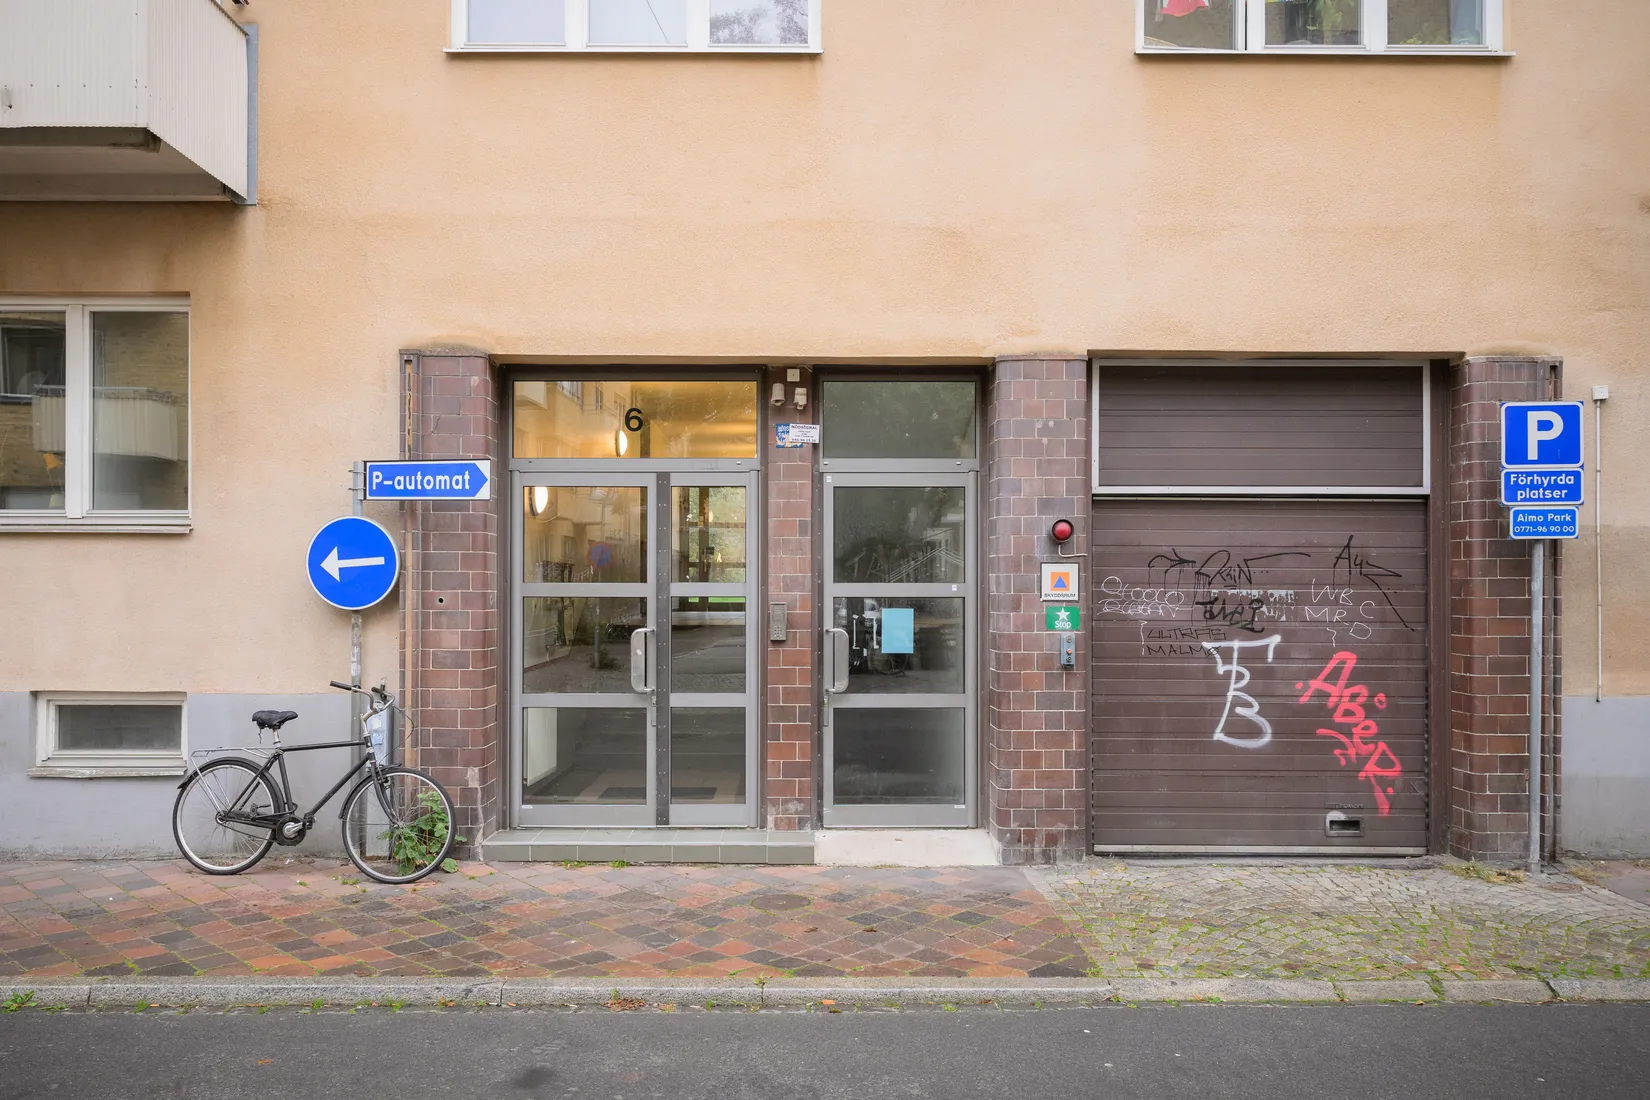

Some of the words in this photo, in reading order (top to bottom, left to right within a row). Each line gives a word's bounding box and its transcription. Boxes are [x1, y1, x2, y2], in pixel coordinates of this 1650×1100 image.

[625, 407, 644, 433] 6
[1527, 410, 1564, 461] P
[372, 470, 471, 490] P-automat
[1510, 474, 1574, 487] Förhyrda
[1516, 487, 1568, 501] platser
[1516, 513, 1544, 523] Aimo
[1547, 513, 1572, 523] Park
[1514, 525, 1548, 534] 0771-96
[1549, 525, 1561, 533] 90
[1562, 525, 1575, 533] 00
[1054, 620, 1072, 630] Stop
